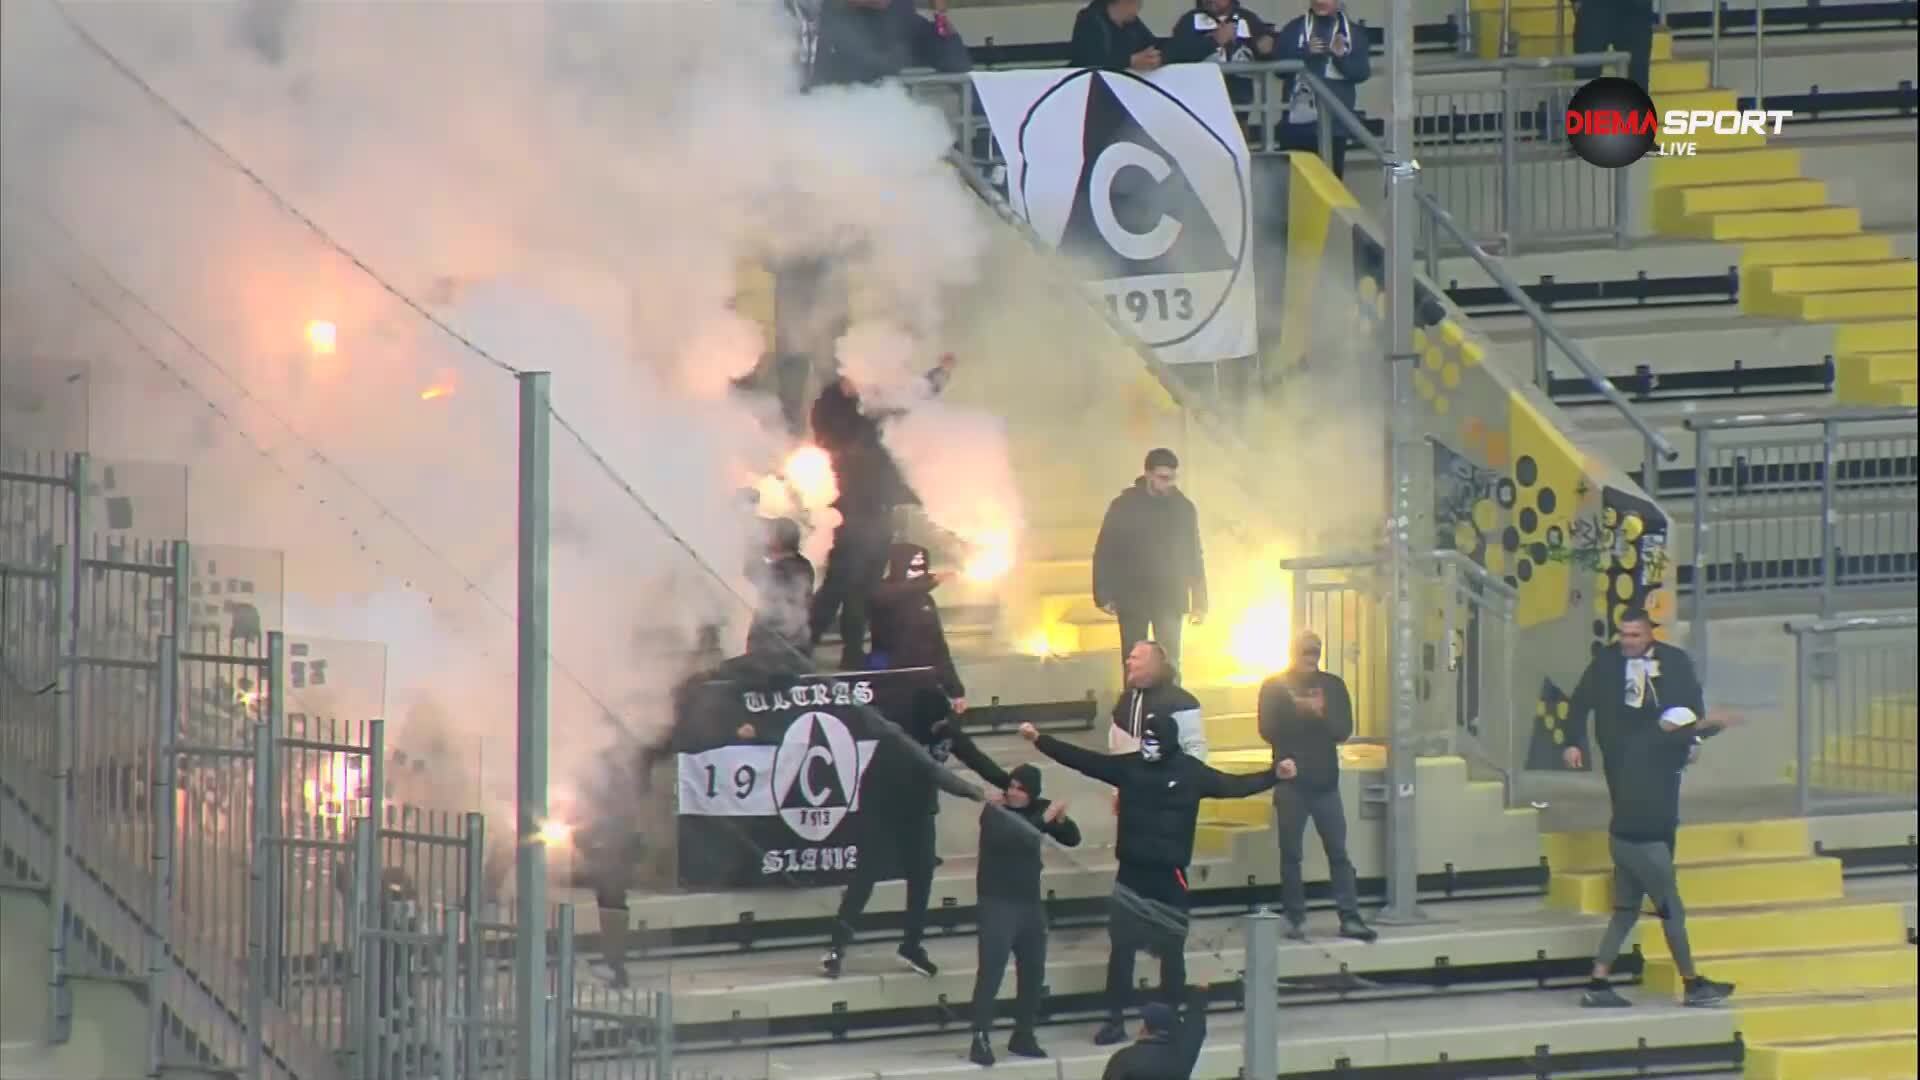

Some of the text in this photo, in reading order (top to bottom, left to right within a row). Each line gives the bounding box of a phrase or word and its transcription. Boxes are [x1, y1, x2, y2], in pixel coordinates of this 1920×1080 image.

[1104, 288, 1193, 322] 1913
[743, 680, 874, 713] ULTRAS
[704, 764, 756, 799] 19
